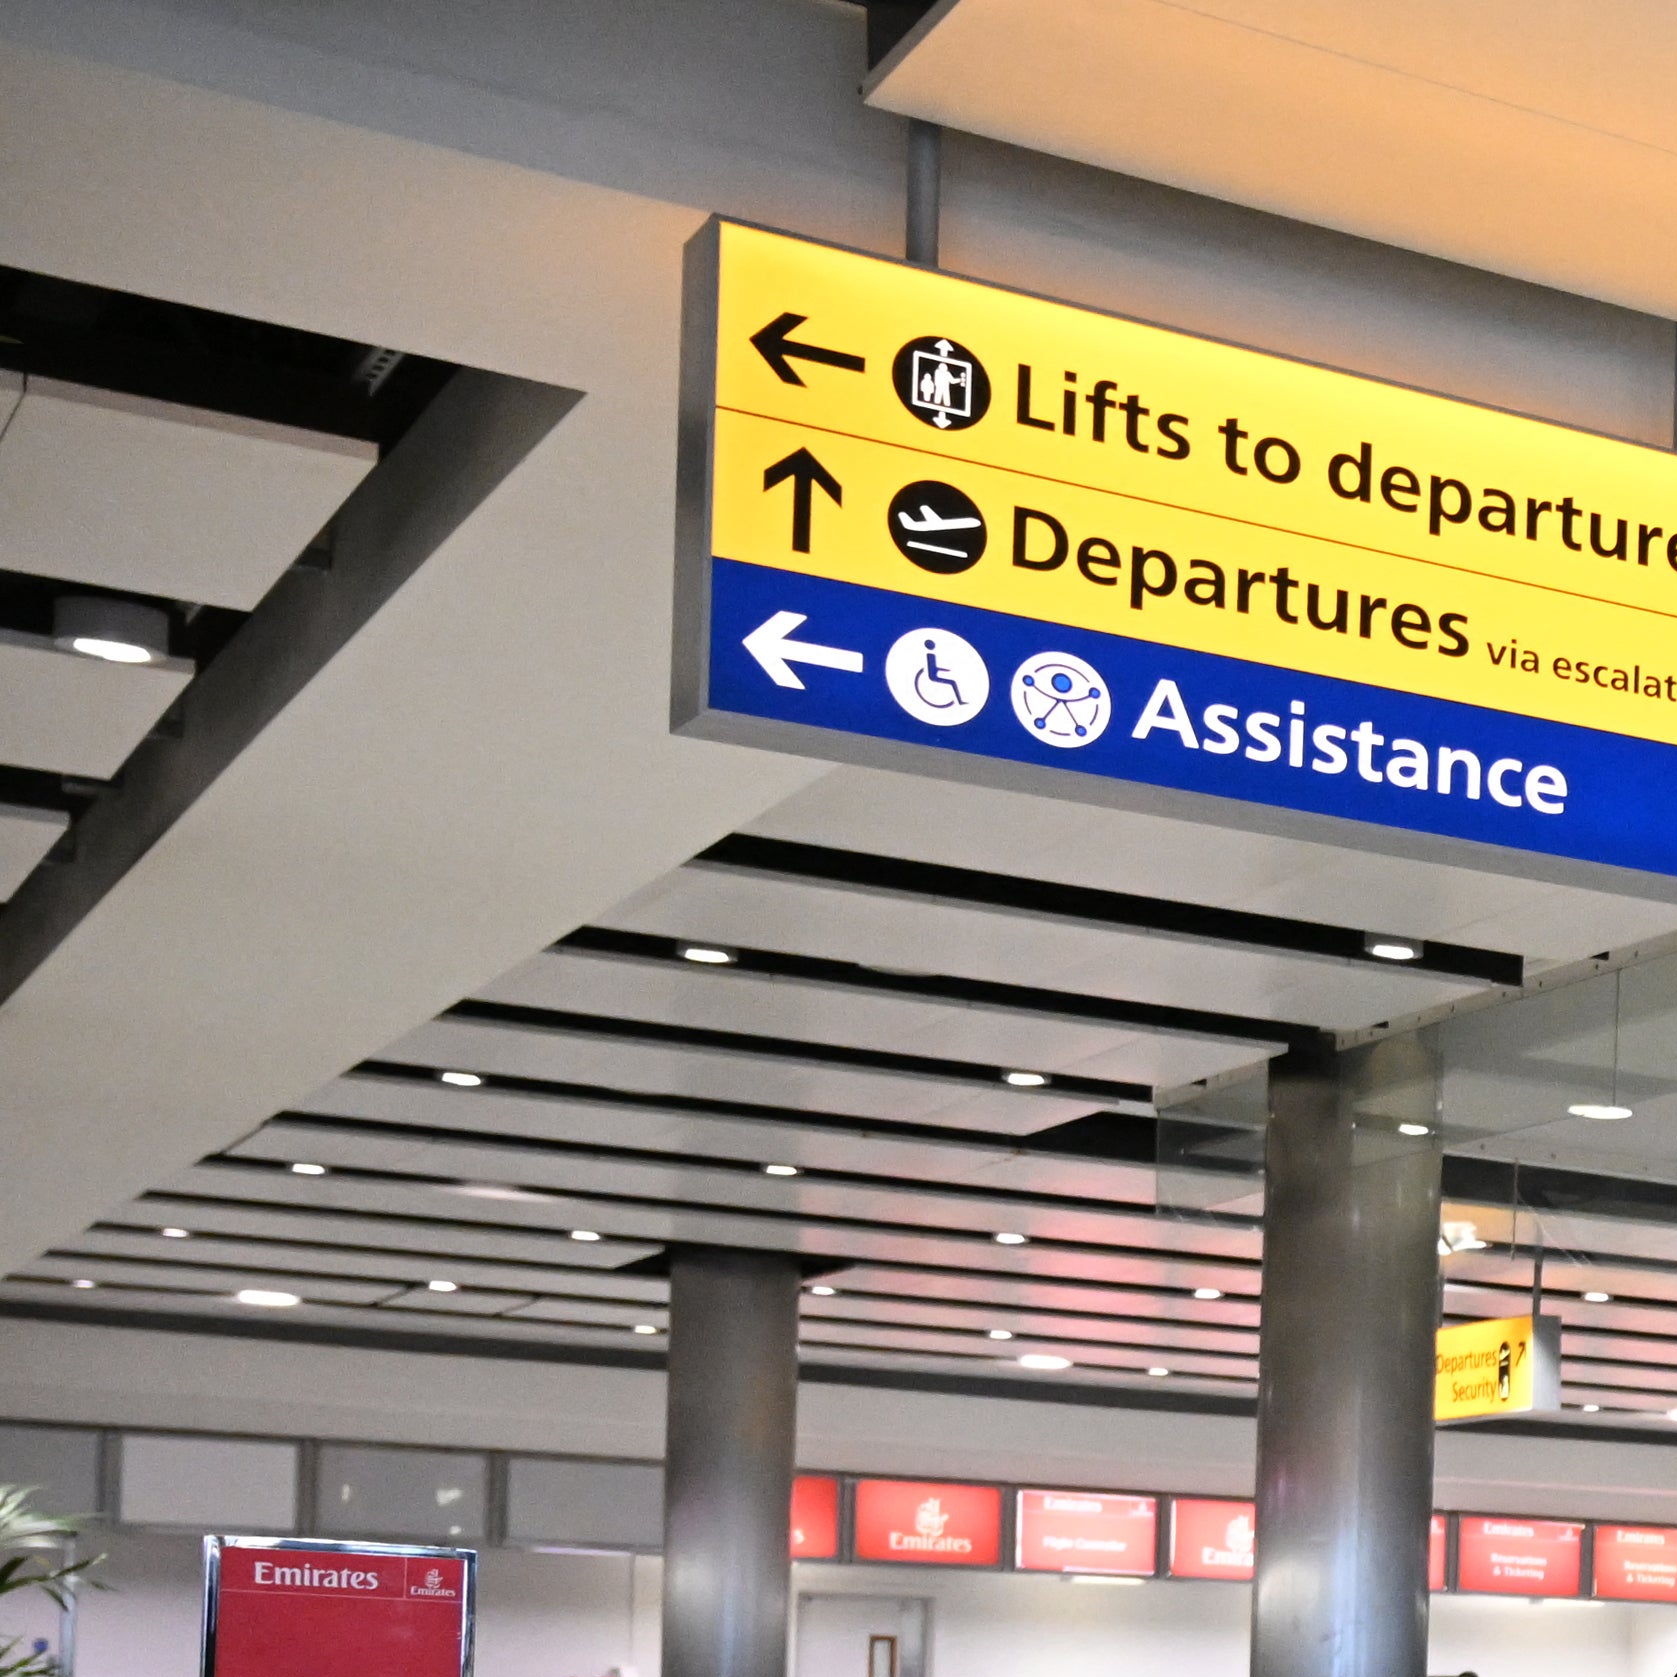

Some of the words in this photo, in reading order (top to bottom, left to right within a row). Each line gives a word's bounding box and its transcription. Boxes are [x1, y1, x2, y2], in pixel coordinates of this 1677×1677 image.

[1015, 363, 1190, 460] Lifts
[1219, 419, 1302, 485] to
[1011, 505, 1469, 658] Departures
[1486, 638, 1543, 675] via
[1132, 678, 1568, 815] Assistance
[1436, 1350, 1498, 1375] Departures
[1452, 1378, 1497, 1404] Security
[889, 1532, 972, 1553] Emirates
[254, 1561, 379, 1590] Emirates
[410, 1586, 456, 1597] Emirates
